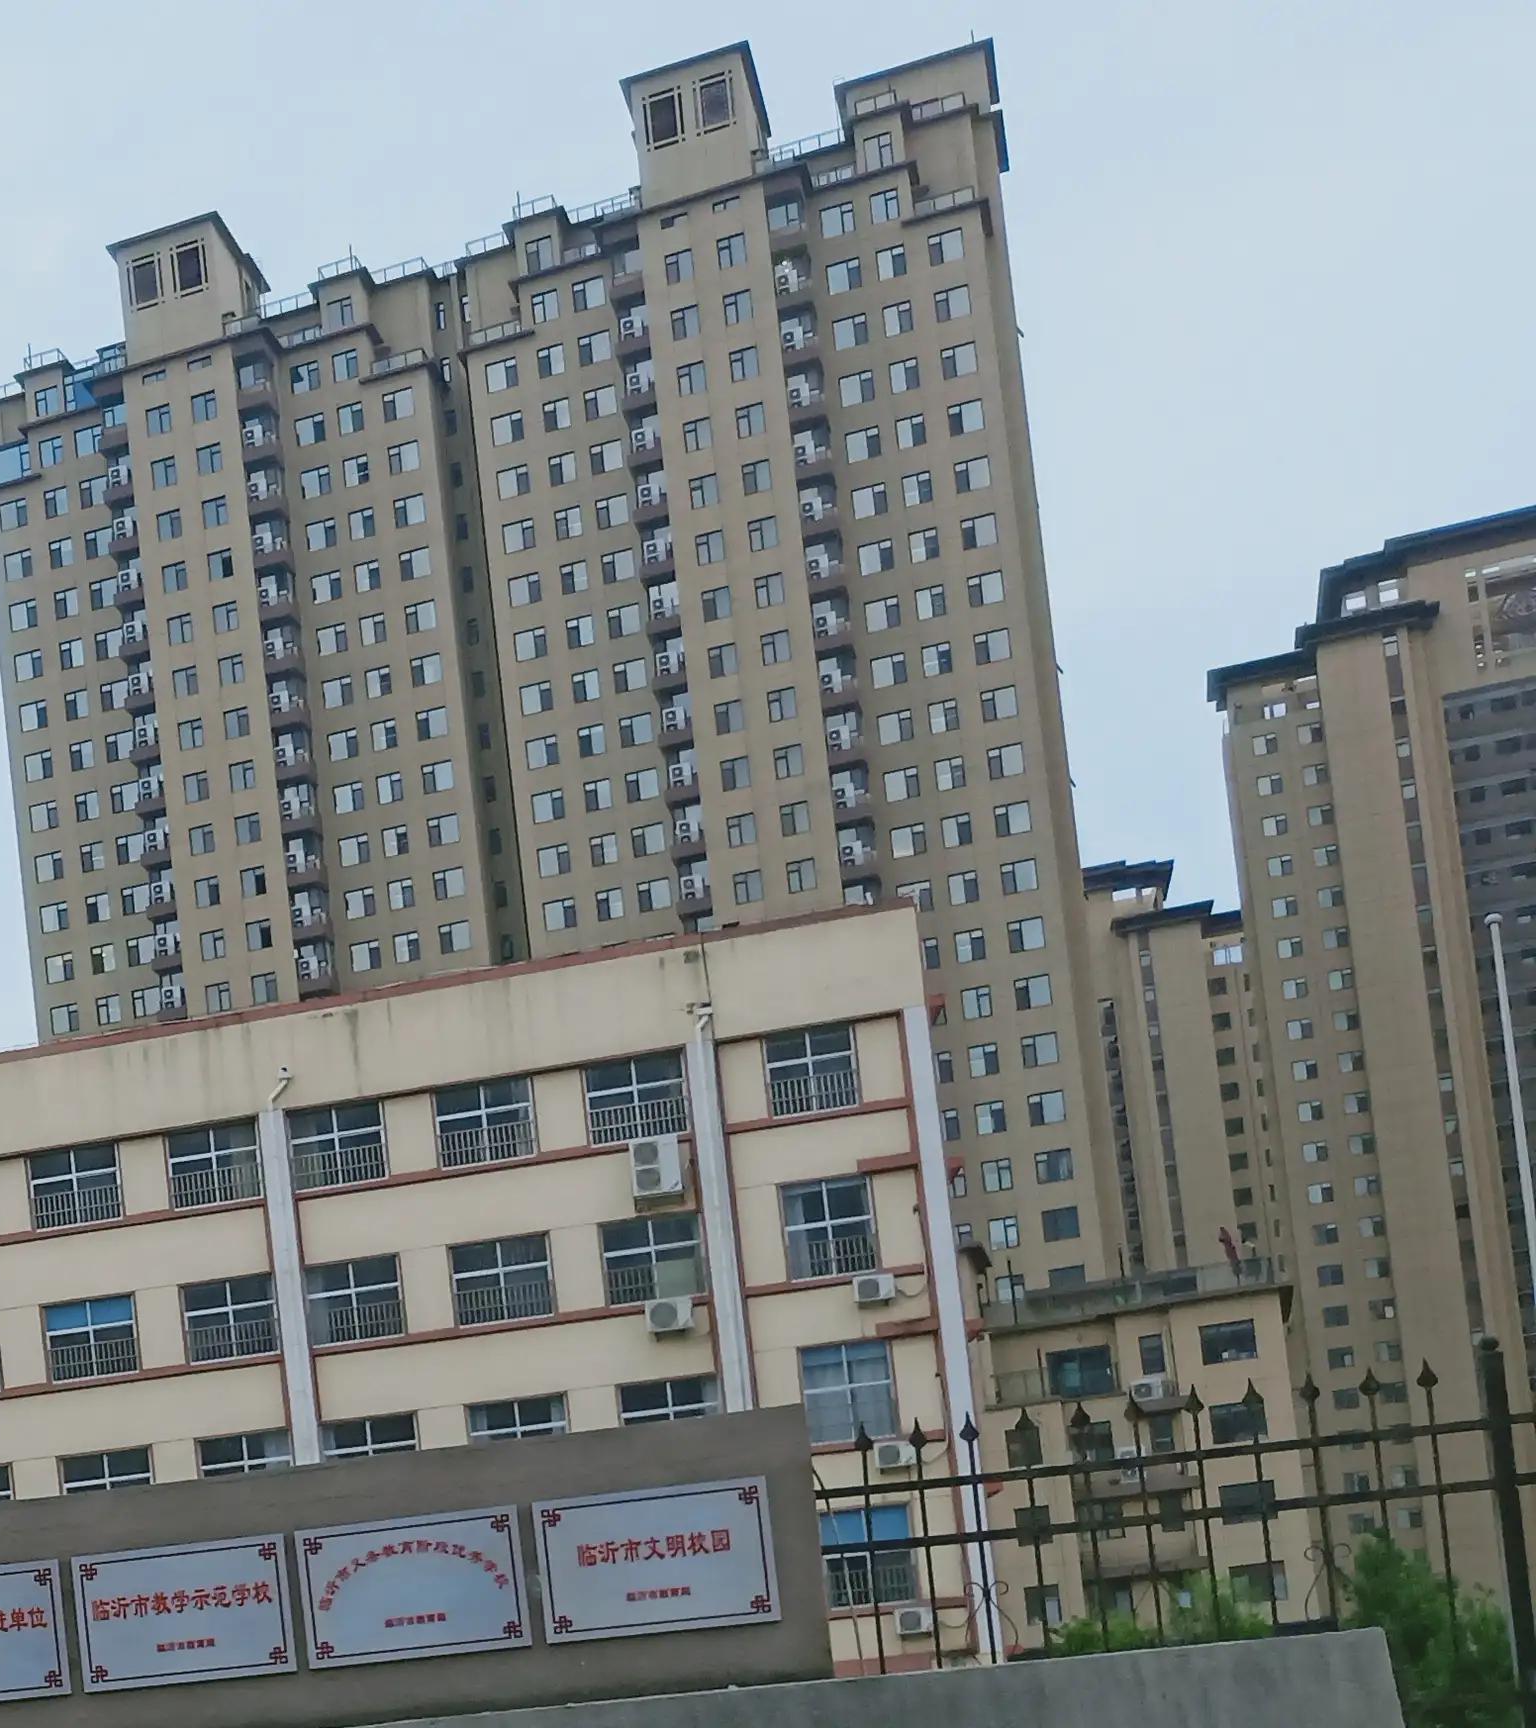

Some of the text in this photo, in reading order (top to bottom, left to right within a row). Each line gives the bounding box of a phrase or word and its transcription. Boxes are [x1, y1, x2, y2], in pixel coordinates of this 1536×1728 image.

[576, 1528, 731, 1568] 临沂市文明校园
[91, 1579, 274, 1622] 临沂市教学示范学校
